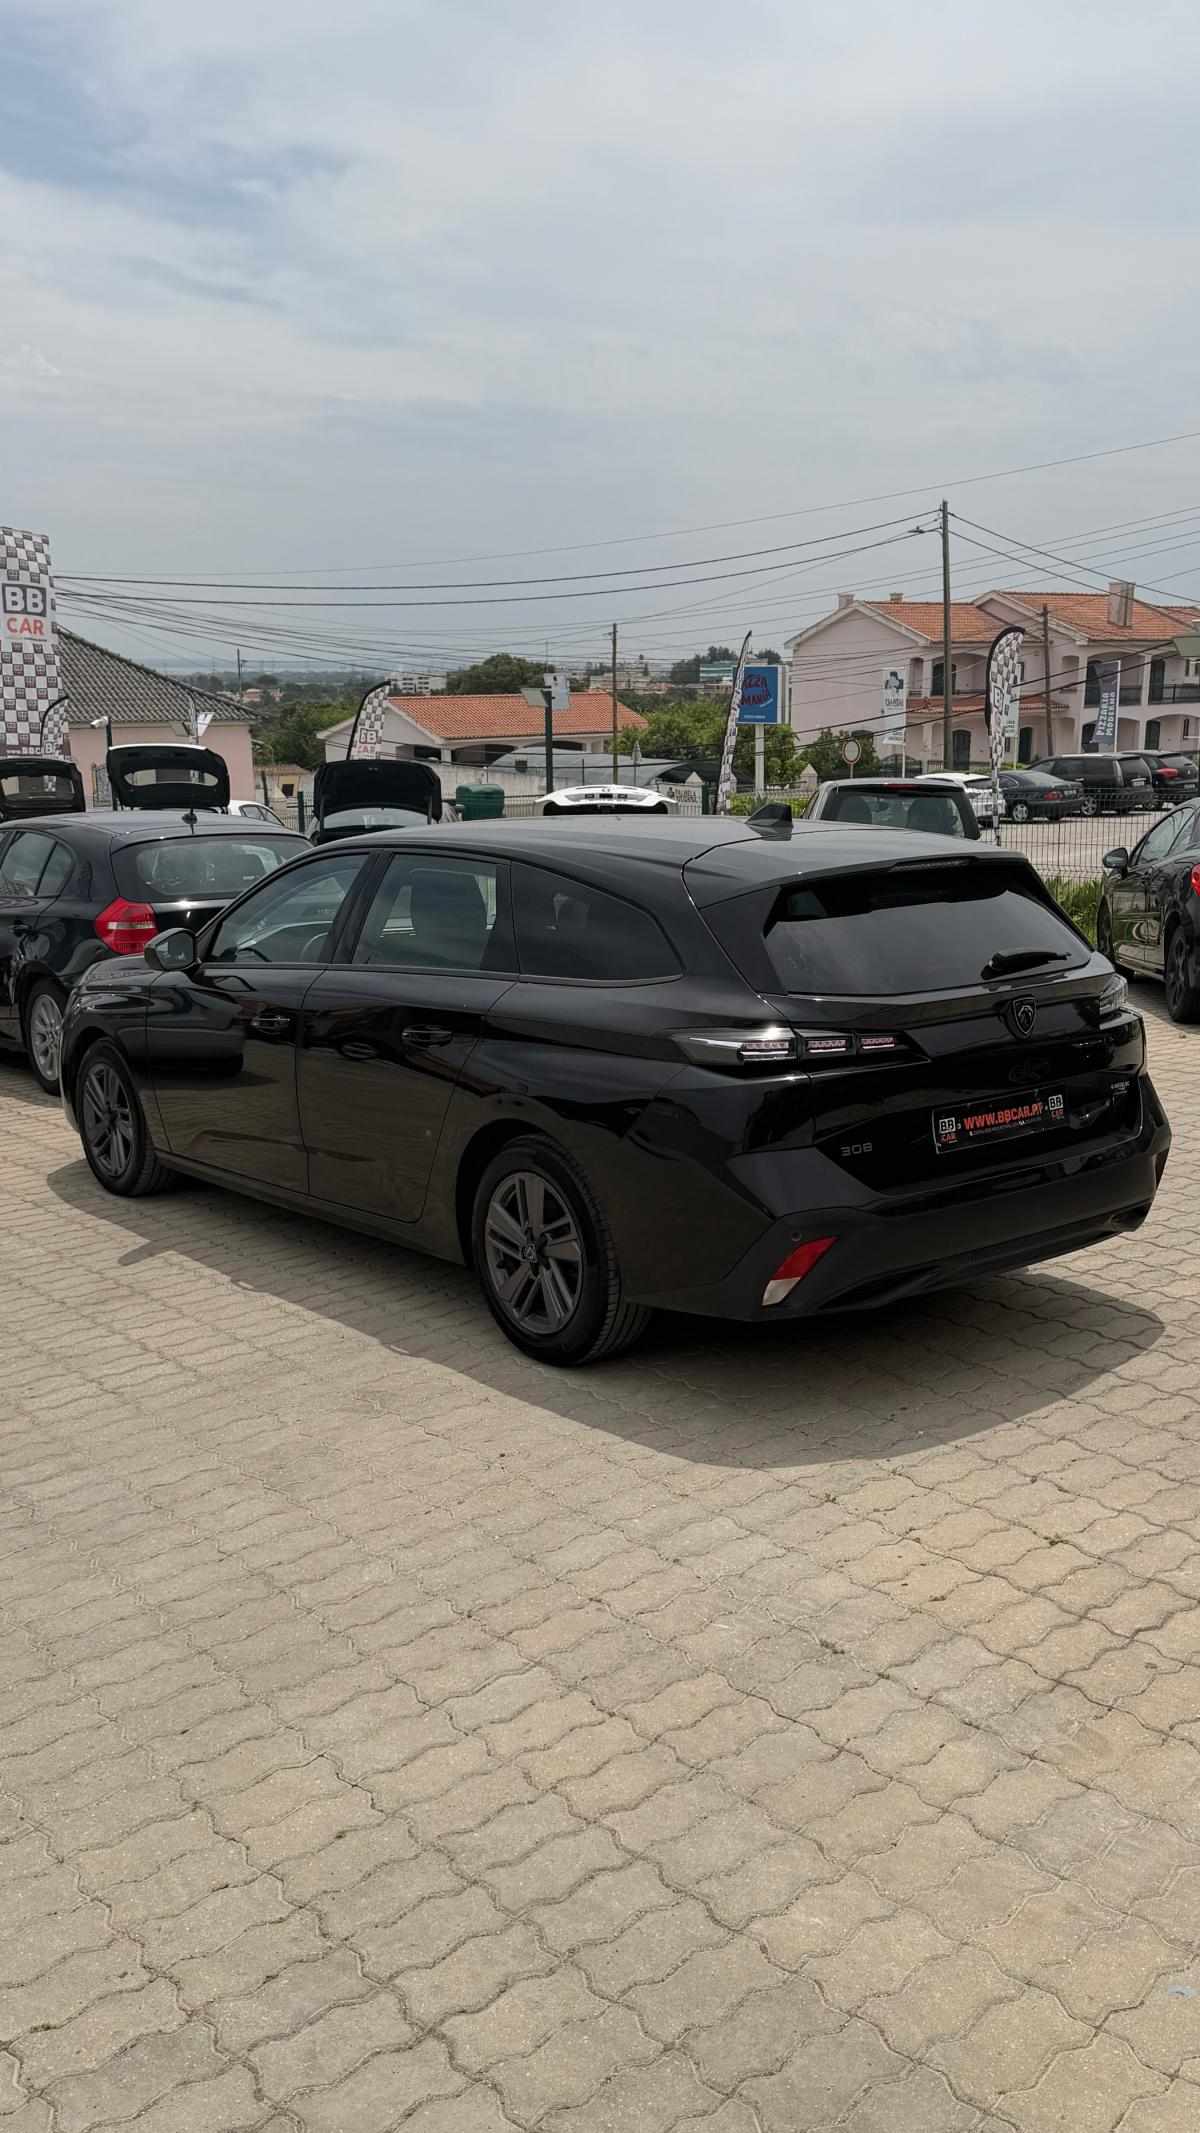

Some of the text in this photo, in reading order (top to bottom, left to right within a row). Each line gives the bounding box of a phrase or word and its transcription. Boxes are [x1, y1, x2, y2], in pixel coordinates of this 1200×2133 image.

[5, 586, 44, 614] BB
[7, 617, 44, 635] CAR
[964, 1103, 1043, 1130] WWW.BBCAR.PT
[840, 1142, 873, 1156] 308
